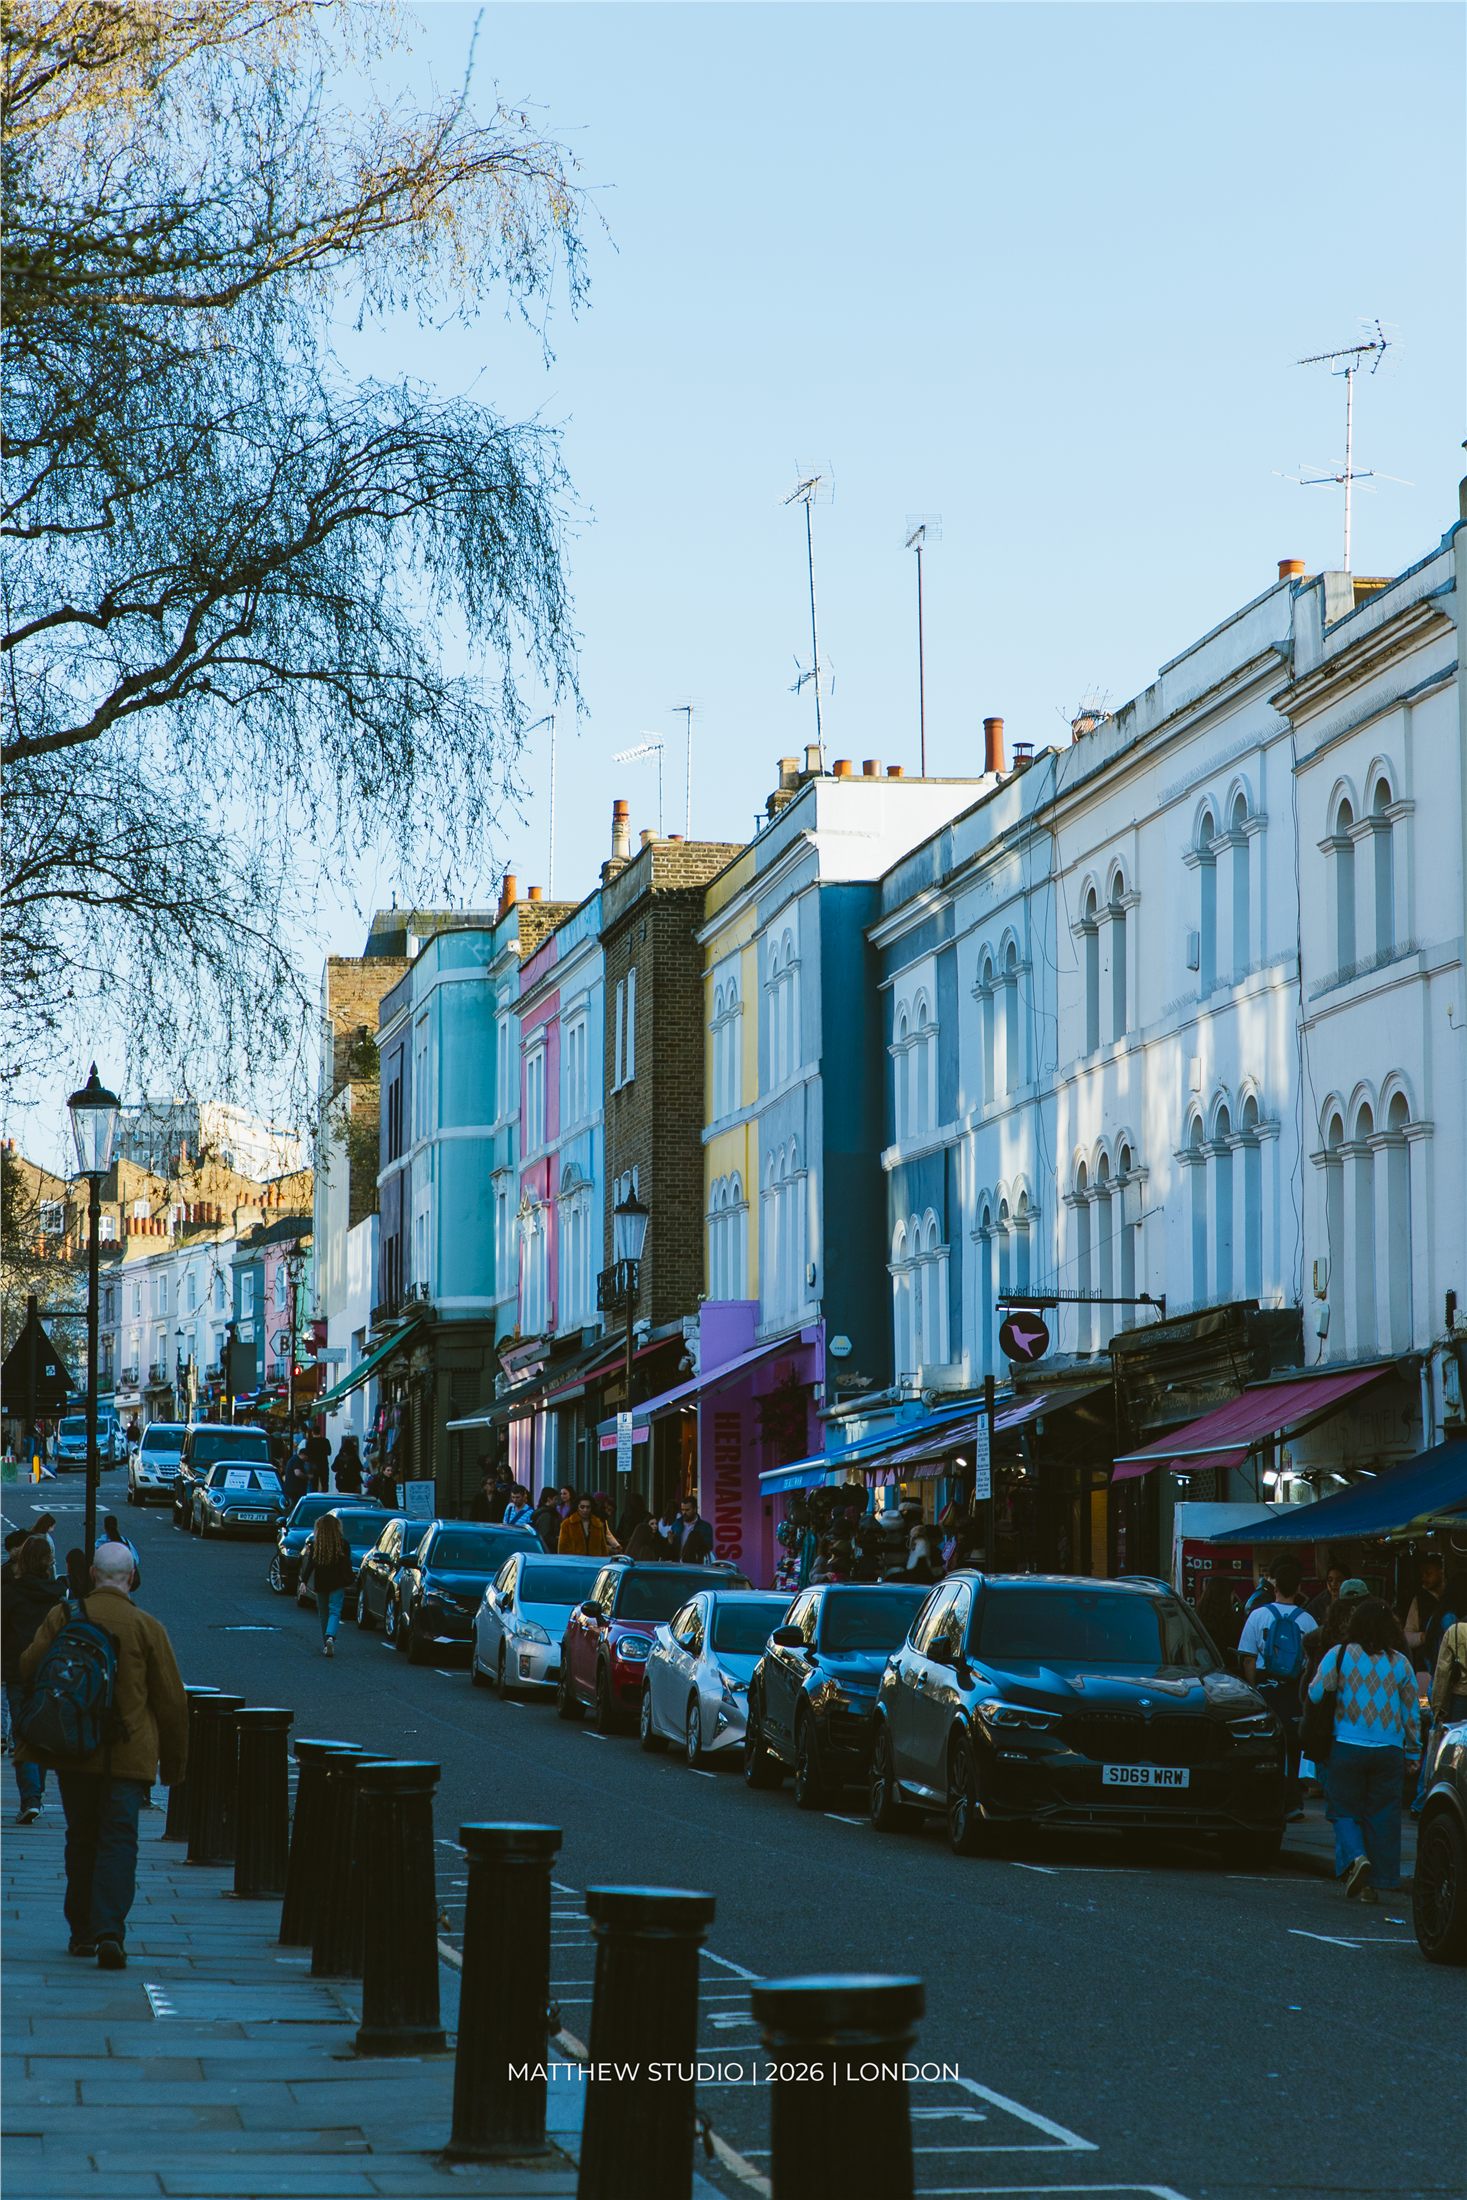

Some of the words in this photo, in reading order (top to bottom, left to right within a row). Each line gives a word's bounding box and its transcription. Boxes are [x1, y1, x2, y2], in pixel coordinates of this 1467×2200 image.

[714, 1411, 743, 1561] HERMANOS
[1109, 1767, 1150, 1783] SD69
[1154, 1769, 1183, 1785] WRW
